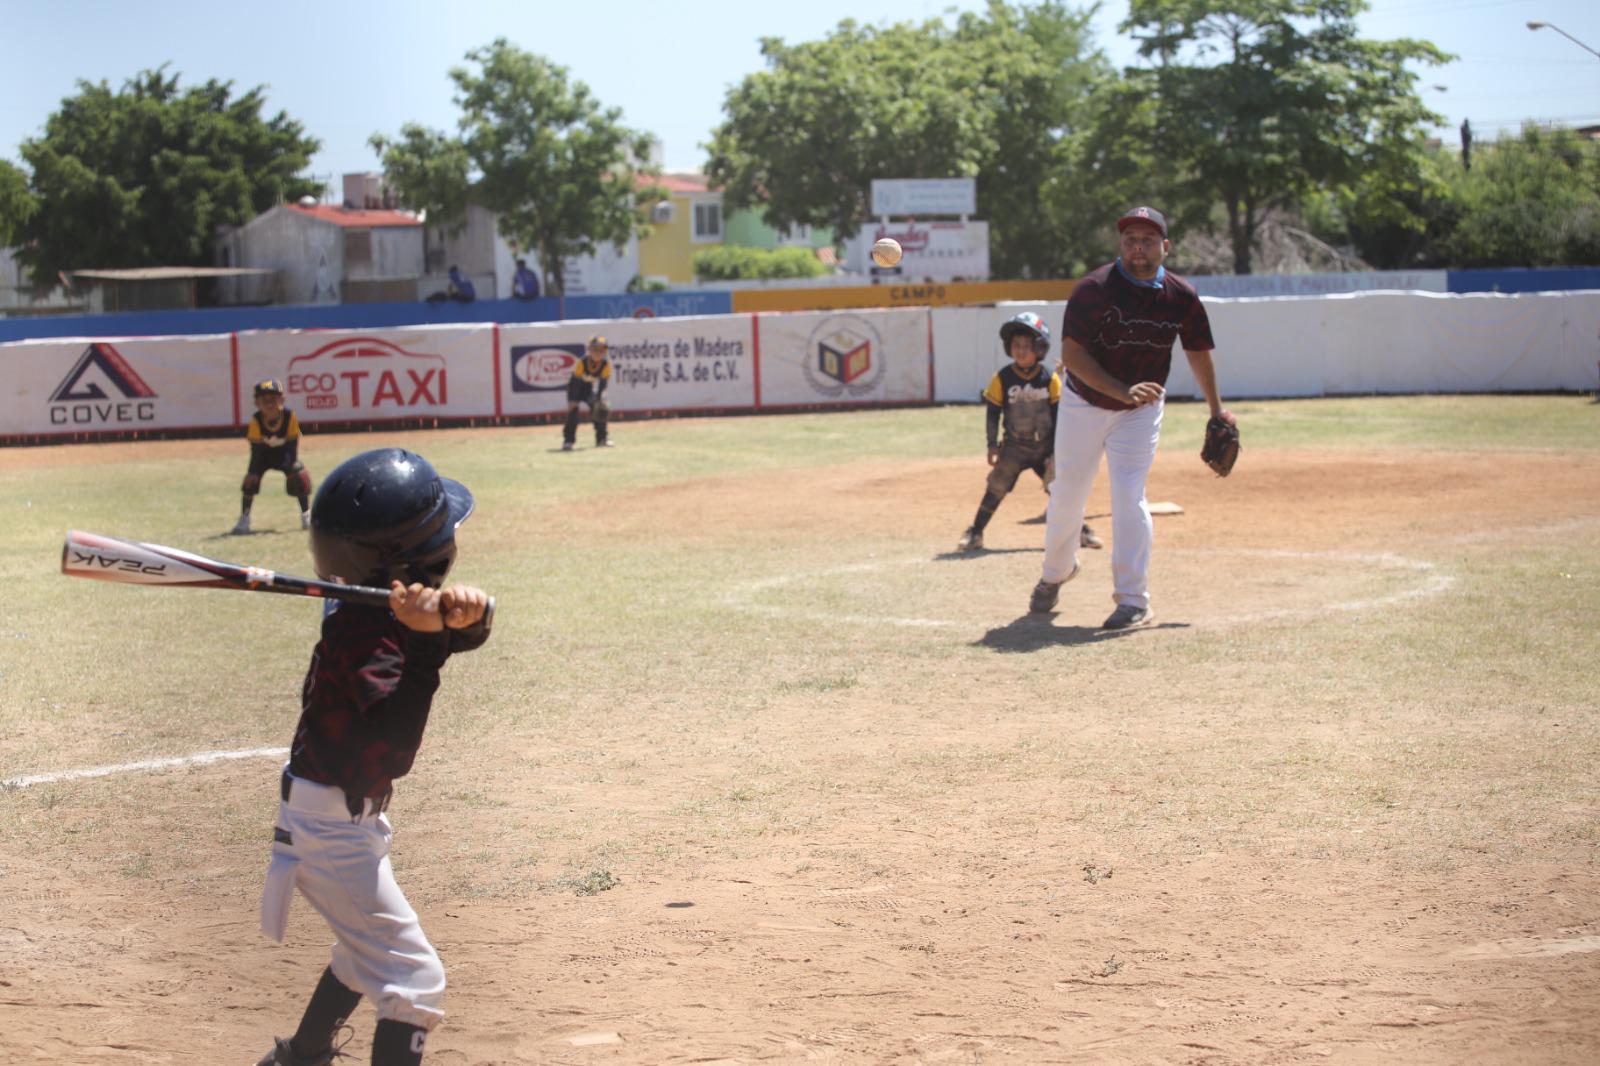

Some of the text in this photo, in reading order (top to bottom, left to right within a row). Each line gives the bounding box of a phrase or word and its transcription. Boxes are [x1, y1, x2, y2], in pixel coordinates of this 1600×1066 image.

[890, 286, 946, 300] CAMPO
[674, 338, 690, 358] de
[694, 336, 744, 357] Madera
[288, 373, 336, 393] ECO
[614, 362, 659, 389] Triplay
[693, 362, 709, 382] de
[340, 368, 448, 408] TAXI
[50, 403, 154, 425] COVEC
[72, 551, 168, 577] PEAK
